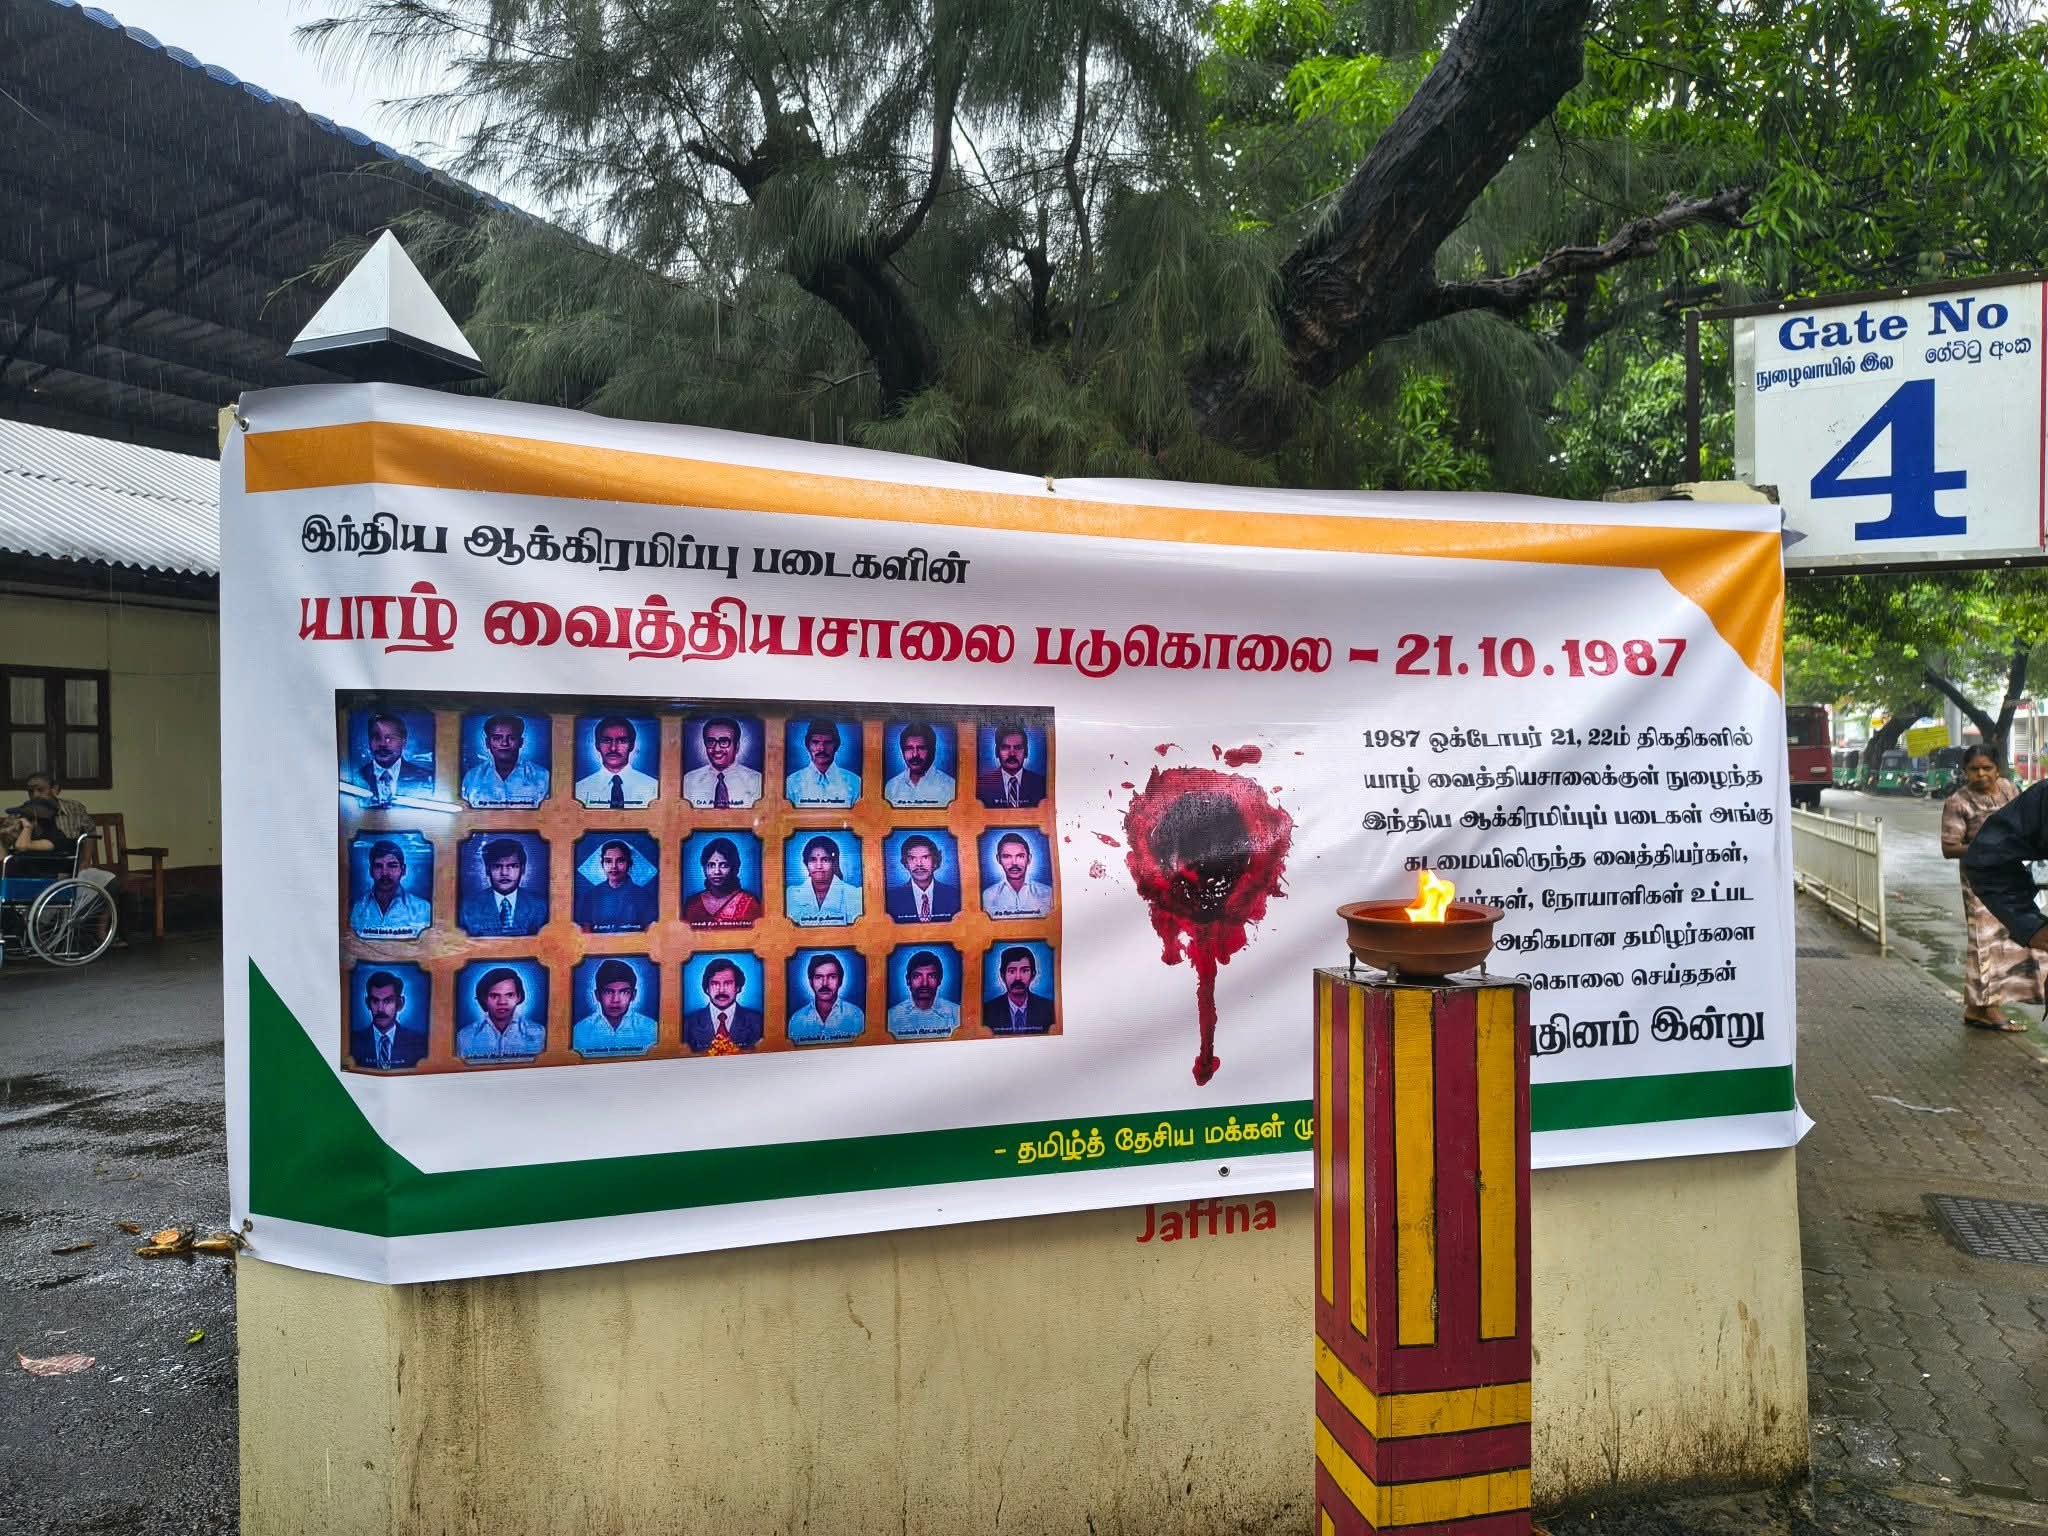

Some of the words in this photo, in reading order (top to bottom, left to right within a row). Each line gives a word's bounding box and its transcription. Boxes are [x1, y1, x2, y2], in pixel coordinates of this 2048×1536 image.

[1778, 309, 1909, 351] Gate
[1927, 296, 2009, 336] No
[1810, 378, 1968, 541] 4
[301, 513, 448, 556] இந்திய
[463, 524, 739, 580] ஆக்கிரமிப்பு
[751, 546, 970, 585] படைகளின்
[299, 581, 458, 655] யாழ்
[483, 594, 1015, 664] வைத்தியசாலை
[1032, 623, 1332, 679] படுகொலை
[1394, 633, 1688, 678] 21.10.1987
[1362, 729, 1420, 749] 1987
[1428, 727, 1543, 753] ஒக்டோபர்
[1550, 728, 1582, 748] 21,
[1588, 725, 1631, 747] 22ம்
[1364, 766, 1420, 794] யாழ்
[1362, 806, 1452, 835] இந்திய
[1614, 802, 1702, 826] படைகள்
[1709, 802, 1773, 825] அங்கு
[1541, 882, 1684, 911] நோயாளிகள்
[1690, 881, 1755, 903] உட்பட
[1494, 926, 1617, 954] அதிகமான
[1622, 921, 1756, 949] தமிழர்களை
[1631, 960, 1737, 987] செய்ததன்
[1650, 1005, 1766, 1049] இன்று
[1017, 1127, 1105, 1164] தமிழ்த்
[1114, 1121, 1194, 1154] தேசிய
[1204, 1113, 1285, 1144] மக்கள்
[1136, 1199, 1276, 1243] Jaffna
